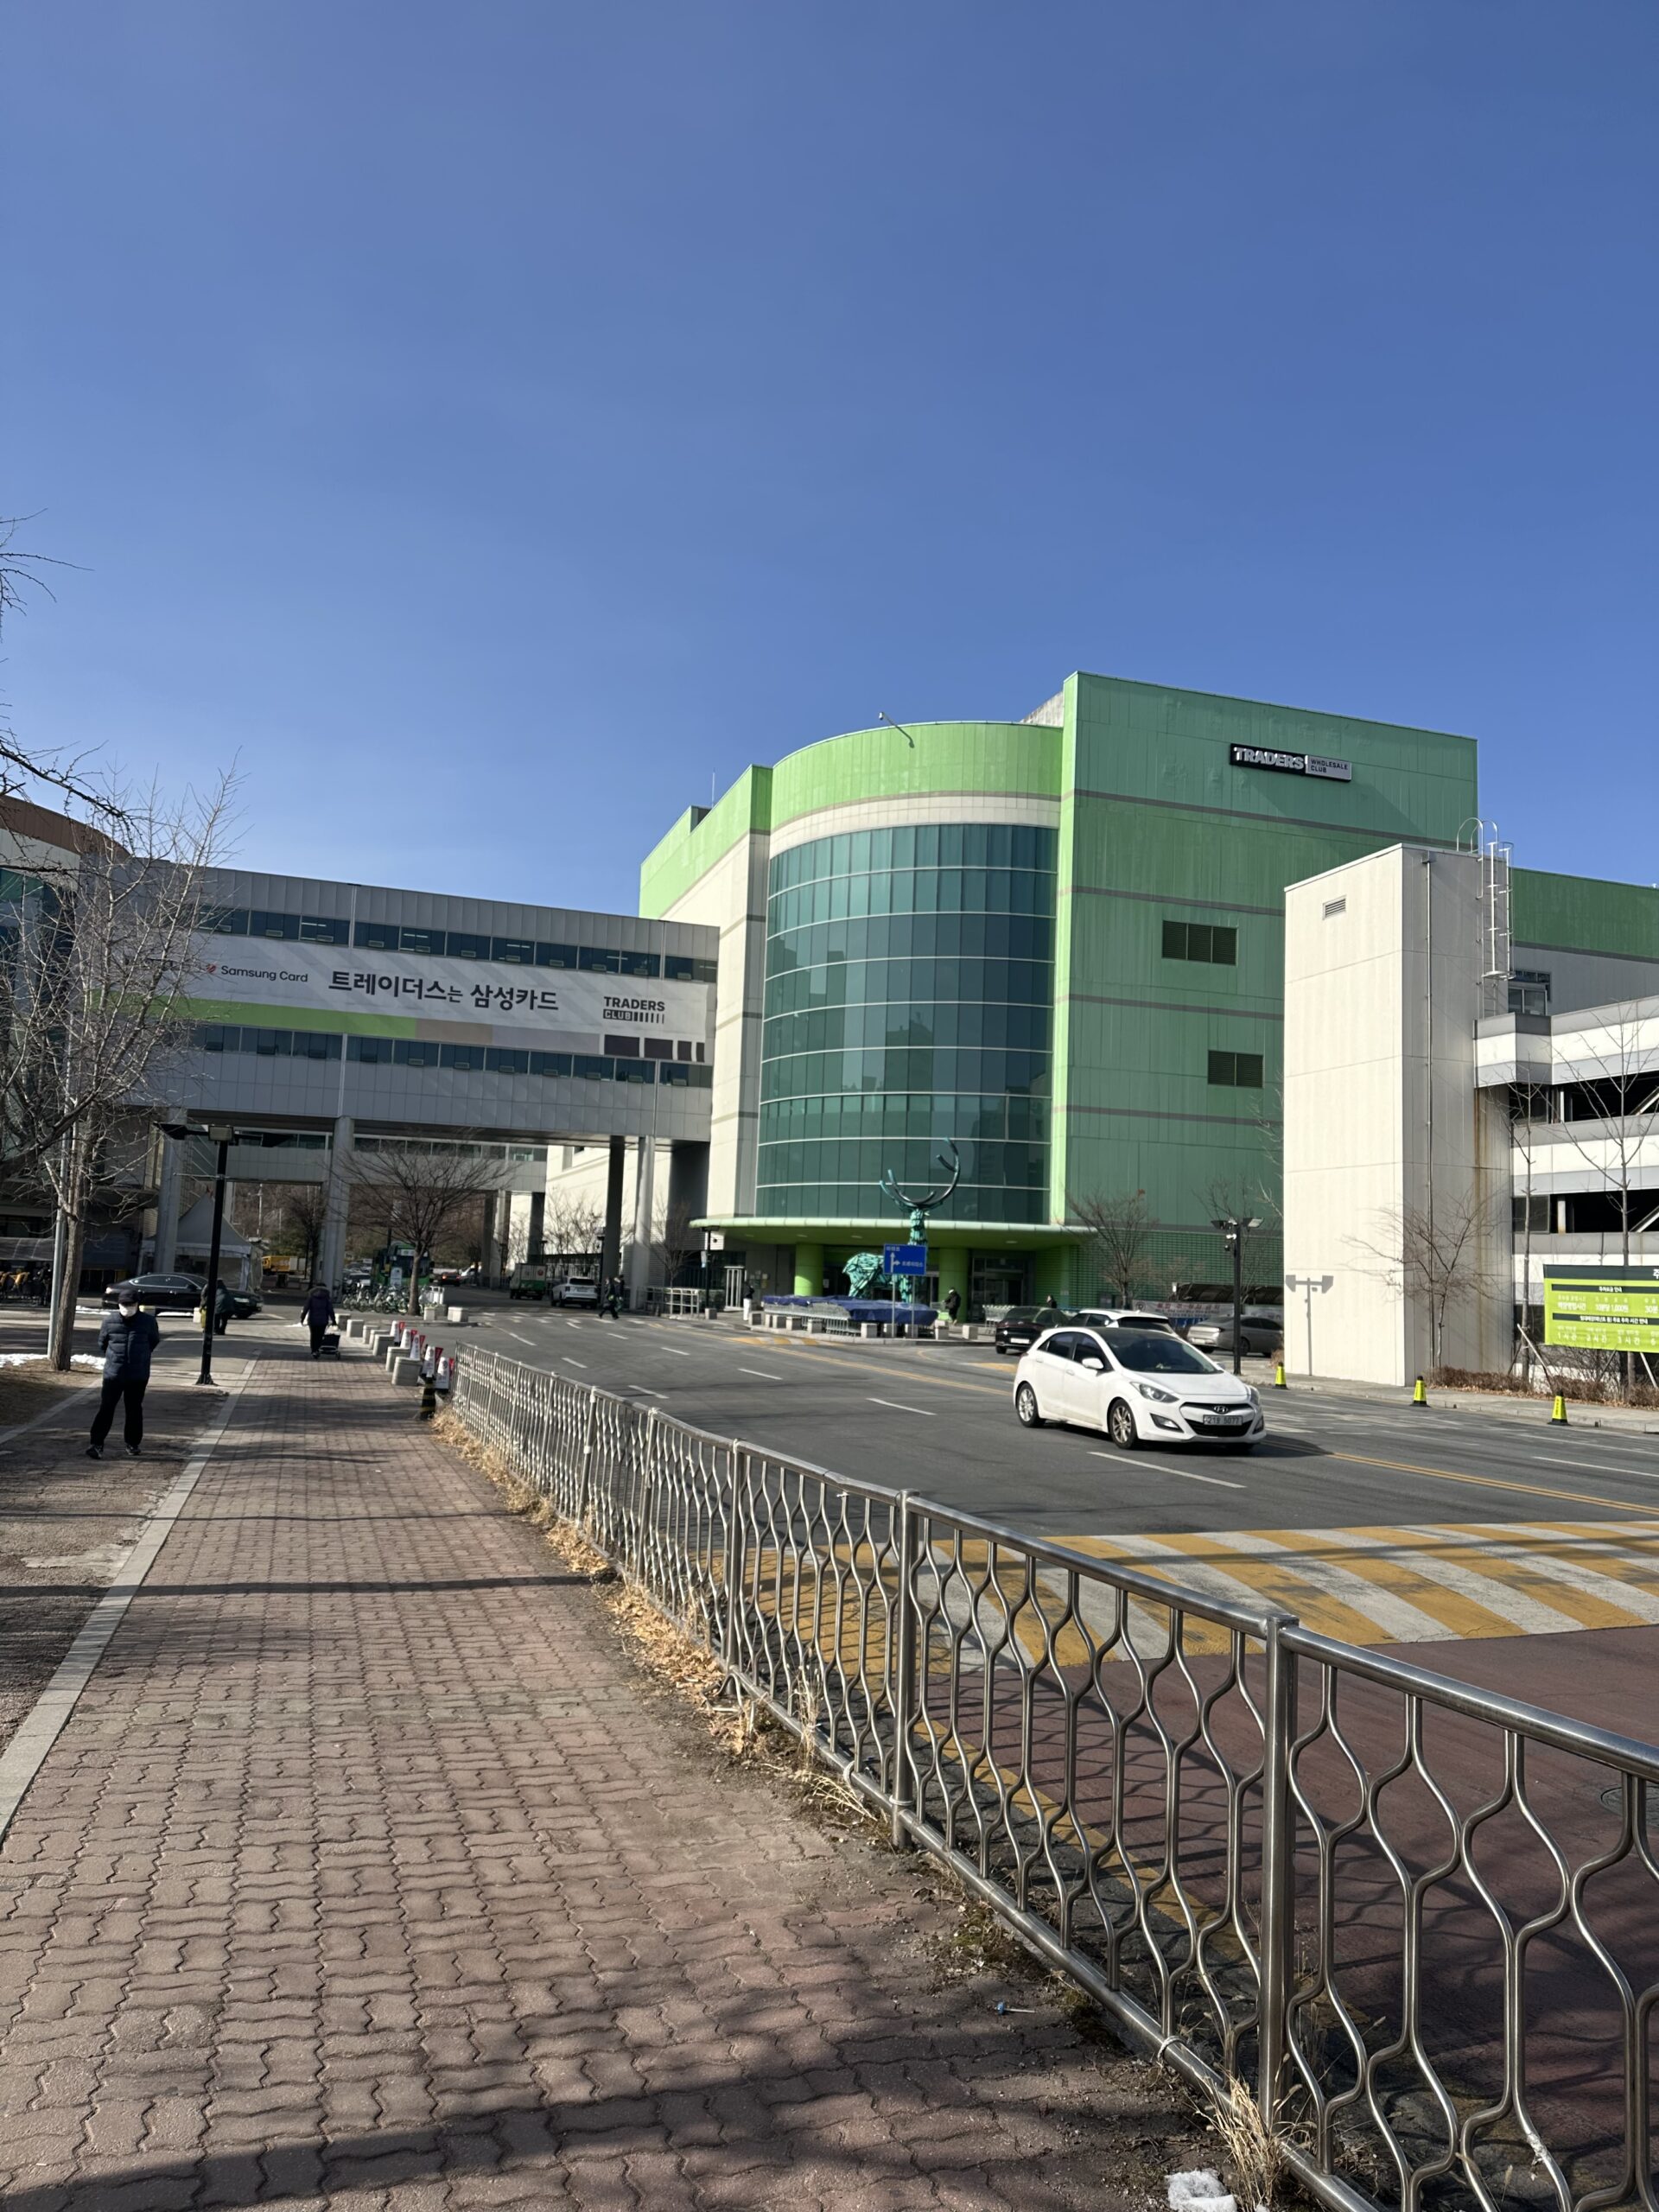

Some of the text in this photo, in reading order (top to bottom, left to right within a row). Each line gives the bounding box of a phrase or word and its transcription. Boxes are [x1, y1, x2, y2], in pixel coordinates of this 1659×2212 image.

[1234, 747, 1304, 770] TRADERS
[1311, 759, 1348, 770] WHOLESALE
[221, 965, 308, 982] Samsung Card
[328, 970, 560, 1011] 트레이더스는 삼성카드
[603, 996, 665, 1012] TRADERS
[605, 1010, 631, 1020] CLUB
